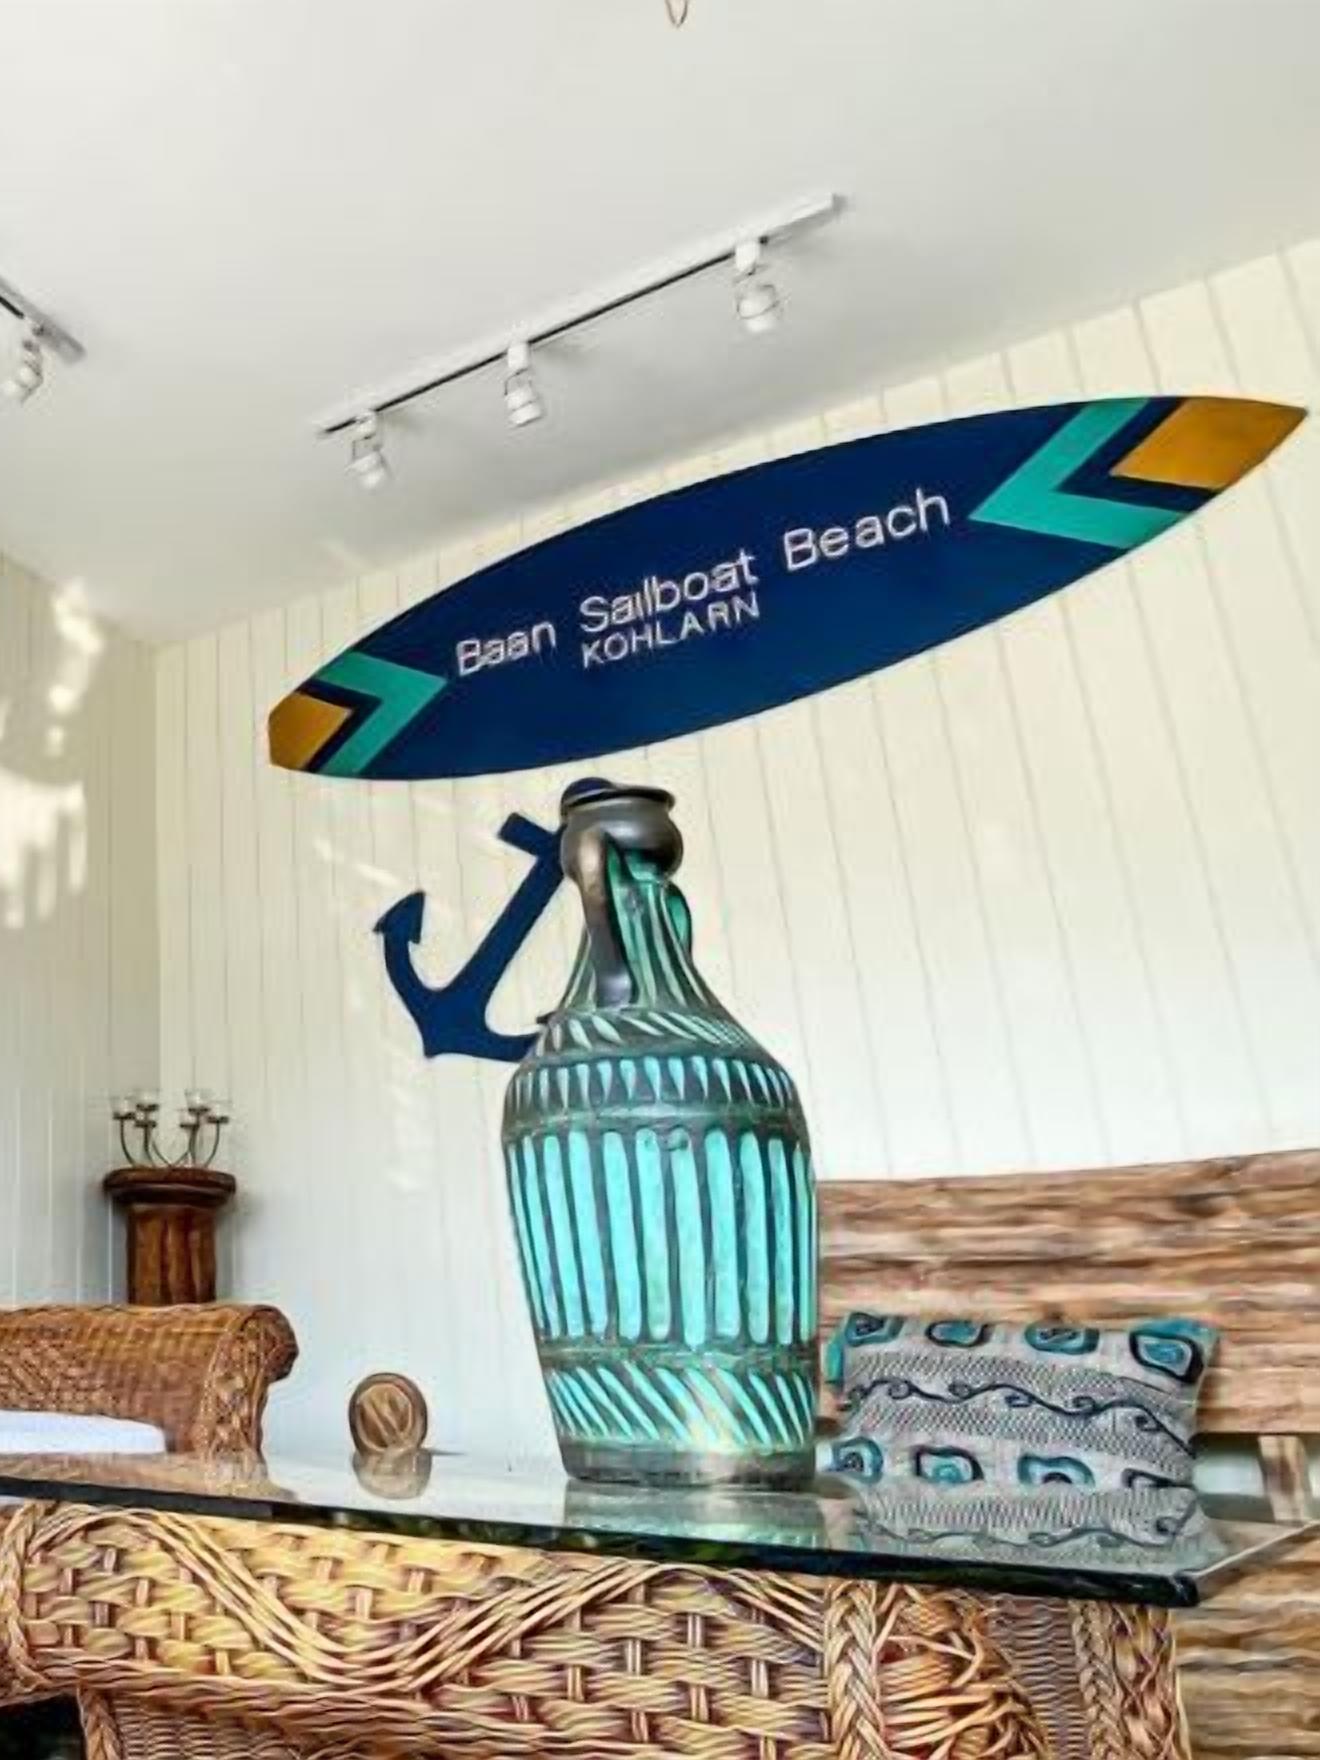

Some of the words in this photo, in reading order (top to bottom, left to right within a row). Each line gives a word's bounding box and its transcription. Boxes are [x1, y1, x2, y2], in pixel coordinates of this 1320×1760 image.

[455, 620, 557, 676] Baan
[580, 549, 760, 633] Sailboat
[783, 488, 950, 571] Beach
[581, 592, 760, 669] KOHLARN
